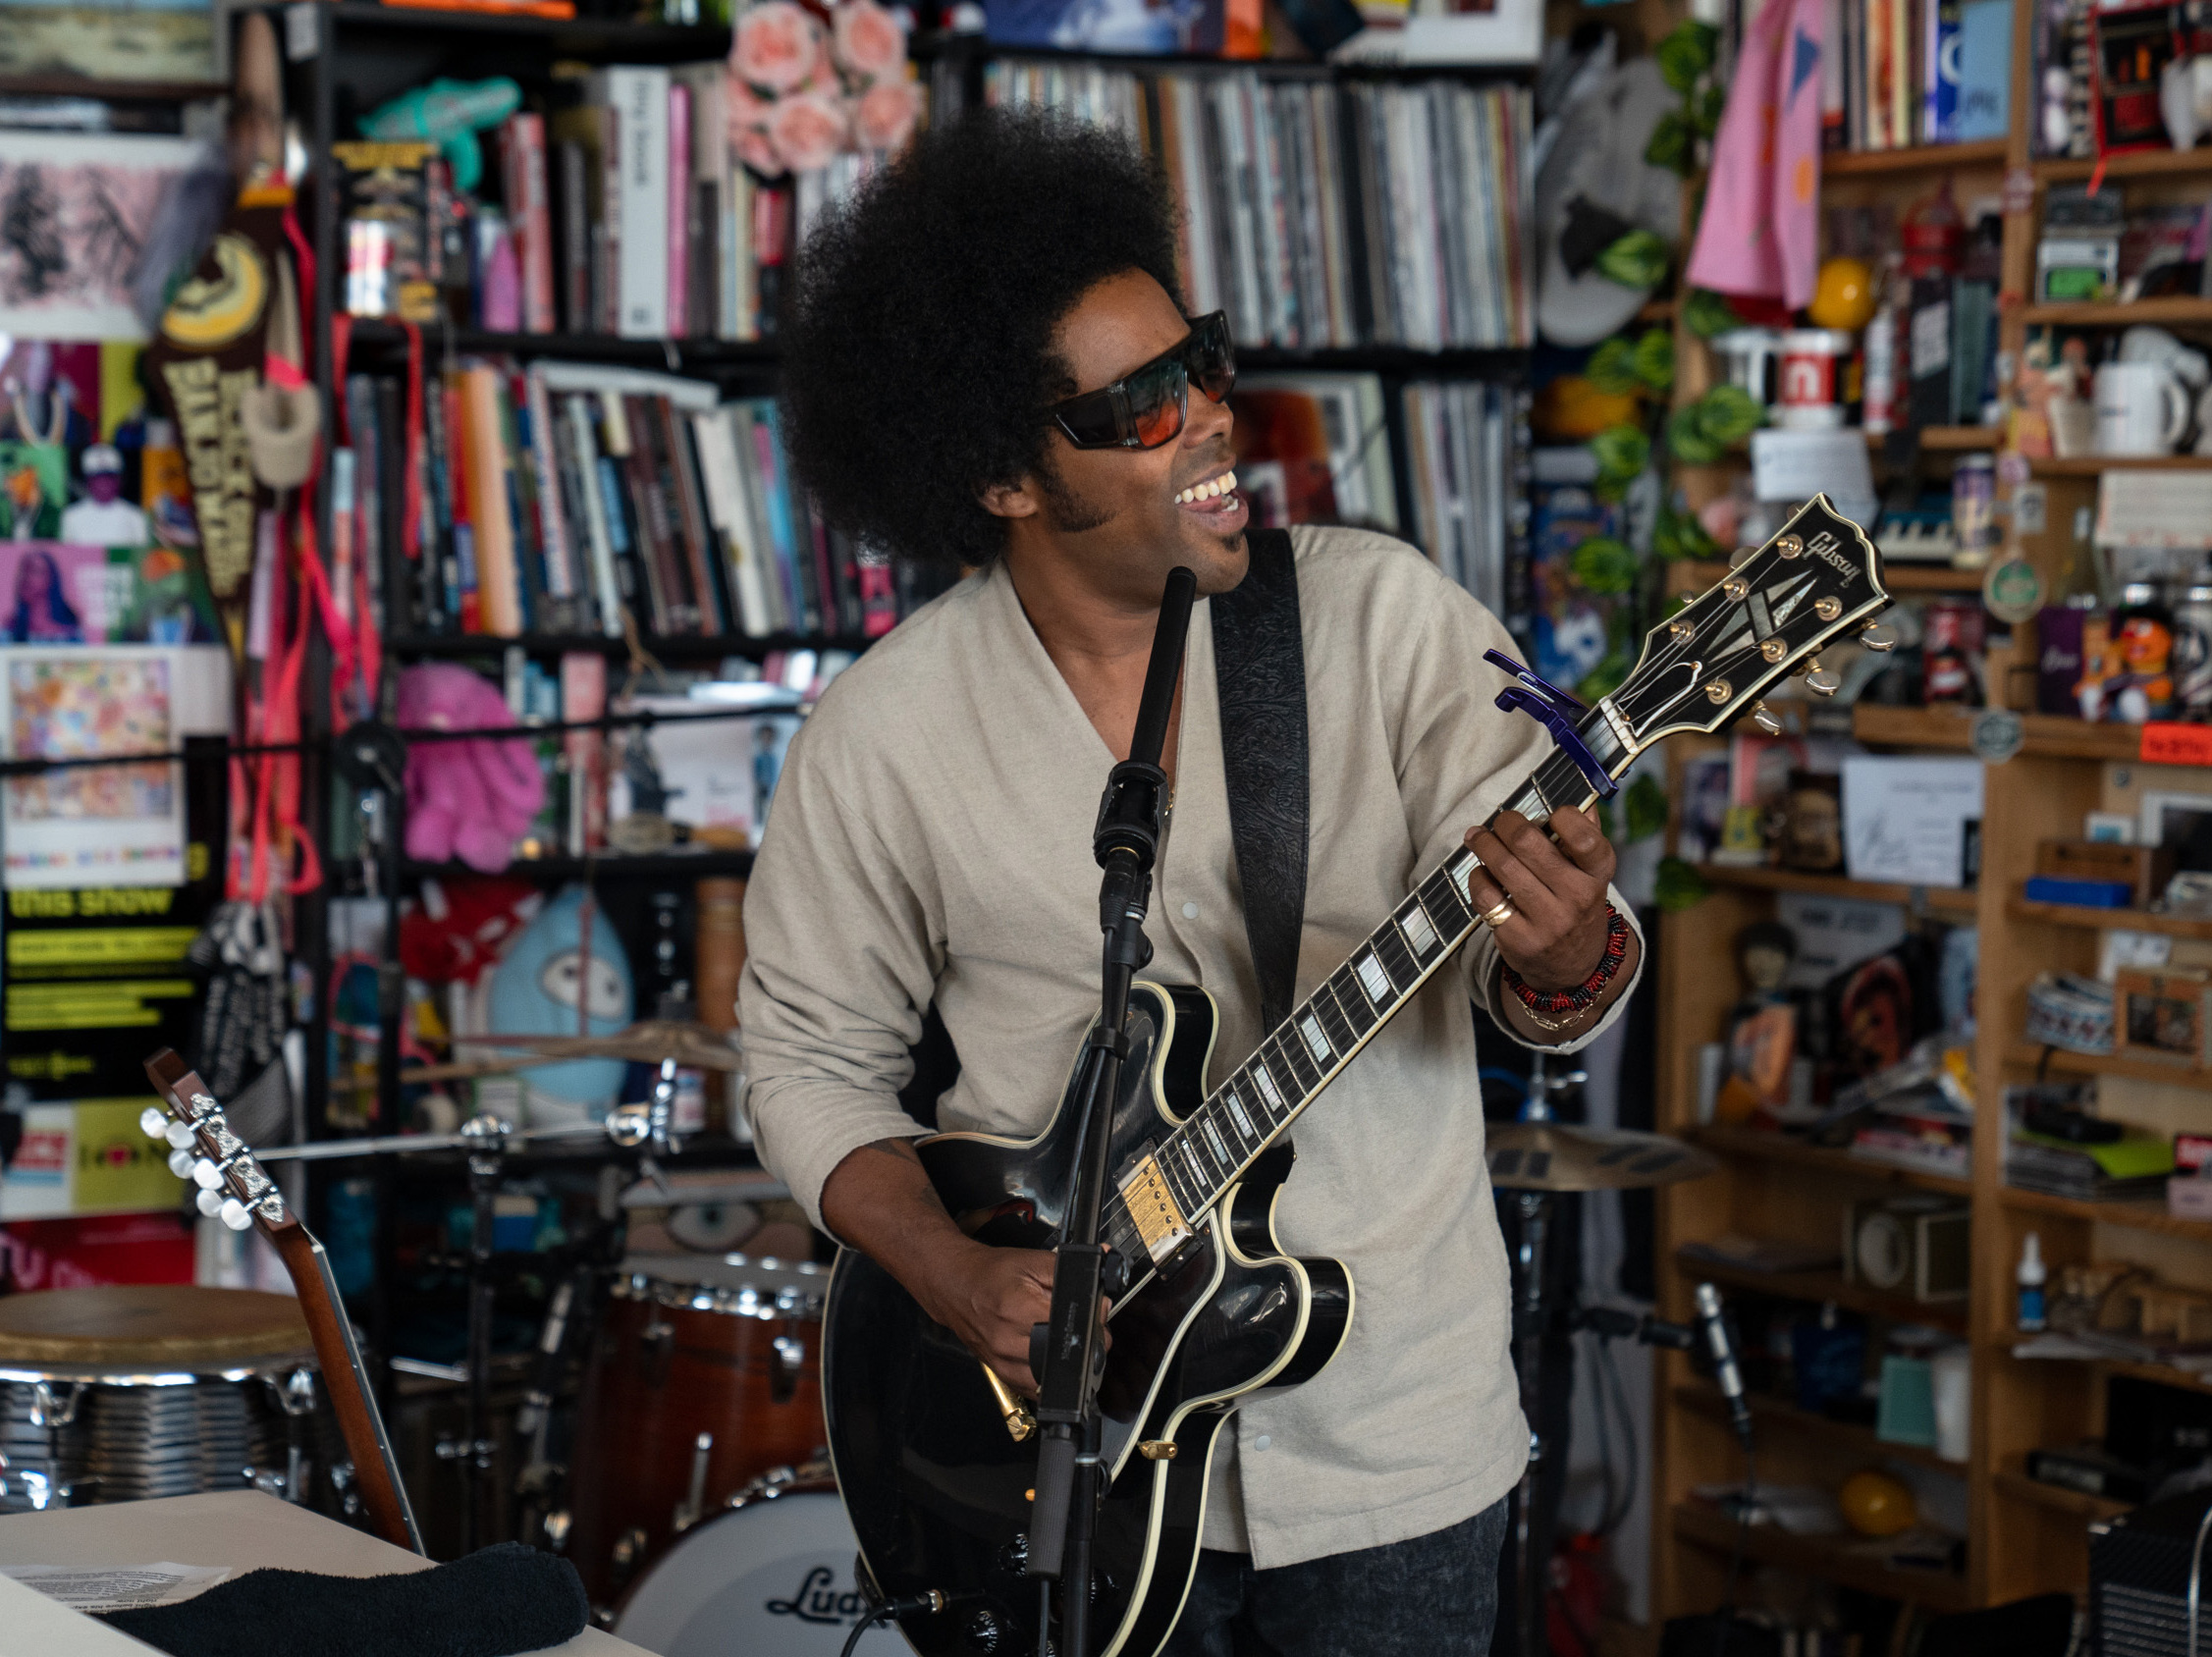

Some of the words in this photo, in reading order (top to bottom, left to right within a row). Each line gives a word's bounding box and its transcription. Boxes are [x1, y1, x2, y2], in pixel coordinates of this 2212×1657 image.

[1803, 531, 1861, 588] Gibson
[9, 887, 75, 919] this
[79, 886, 174, 918] show
[766, 1566, 863, 1625] Lud
